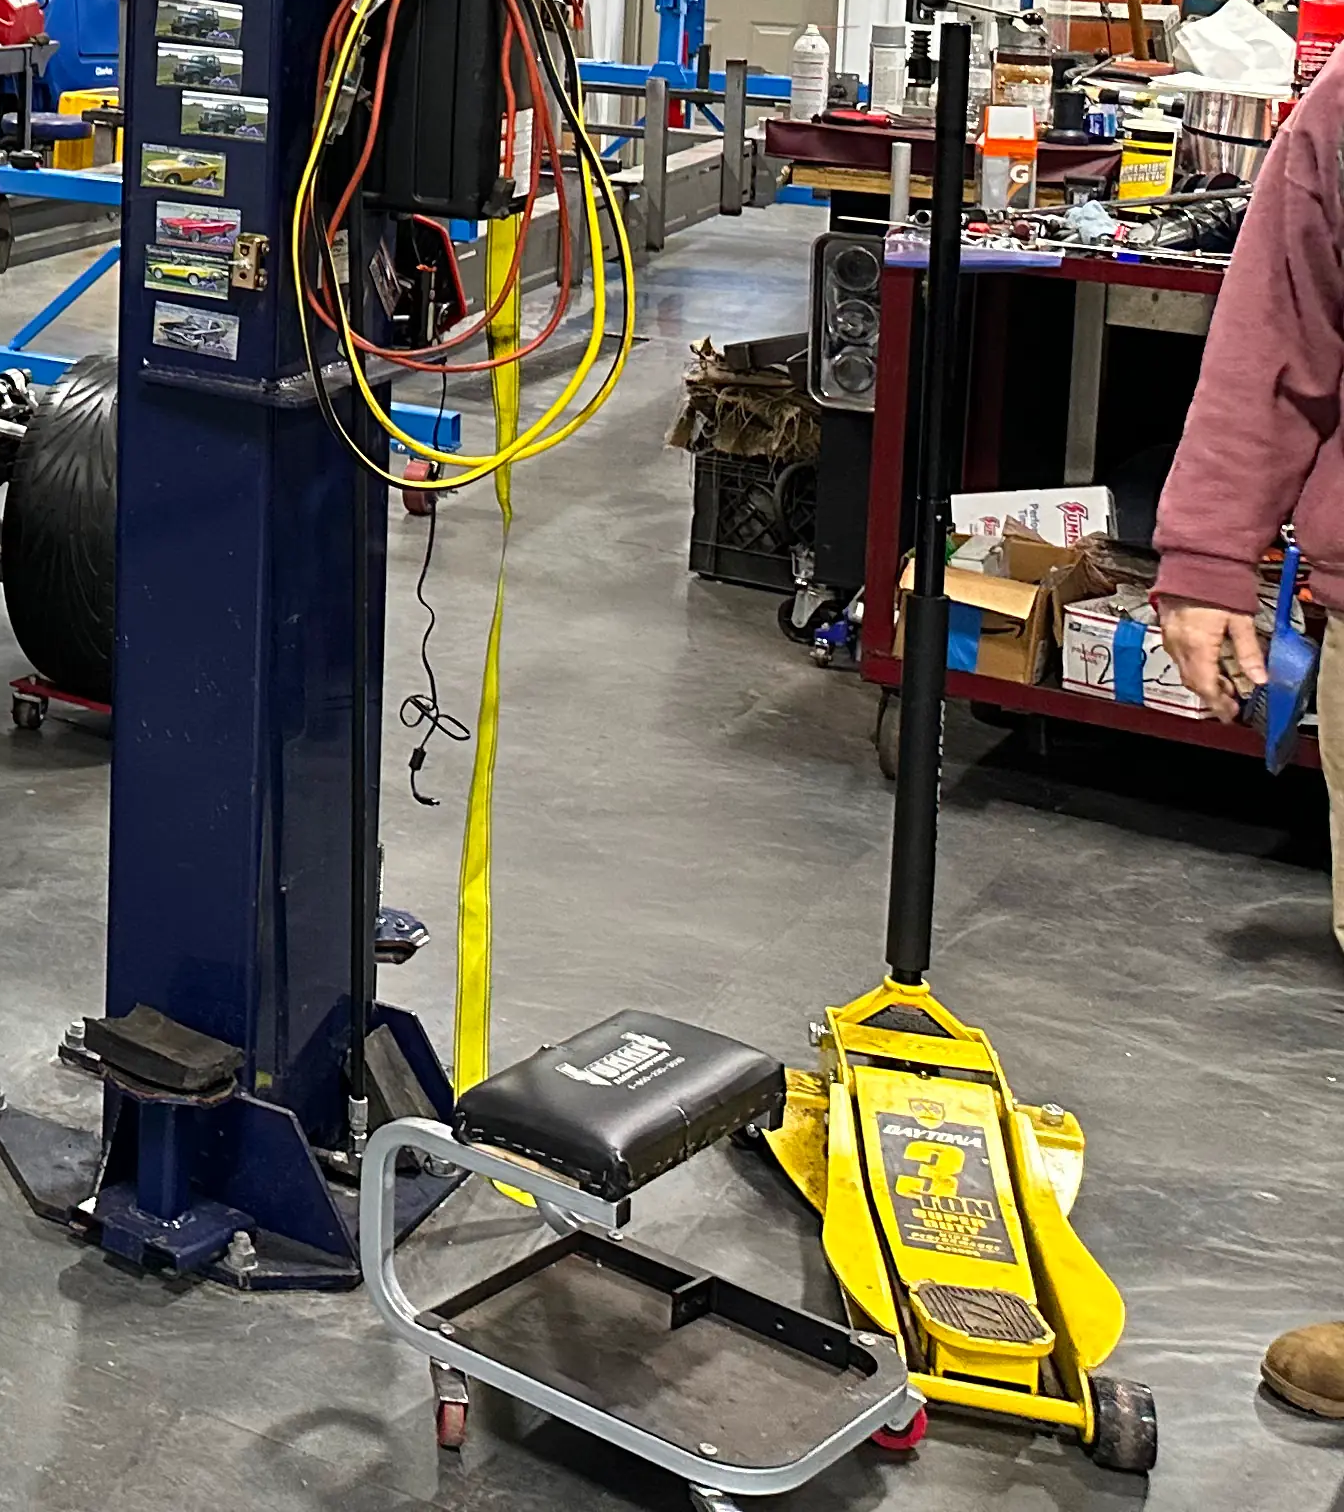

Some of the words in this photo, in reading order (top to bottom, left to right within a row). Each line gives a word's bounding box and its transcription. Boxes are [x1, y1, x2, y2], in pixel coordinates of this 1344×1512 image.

[1010, 164, 1029, 184] G
[882, 1124, 983, 1148] DAYTONA
[896, 1141, 965, 1202] 3
[912, 1208, 988, 1229] SUPER
[919, 1194, 996, 1221] TON
[923, 1219, 980, 1236] DUTY
